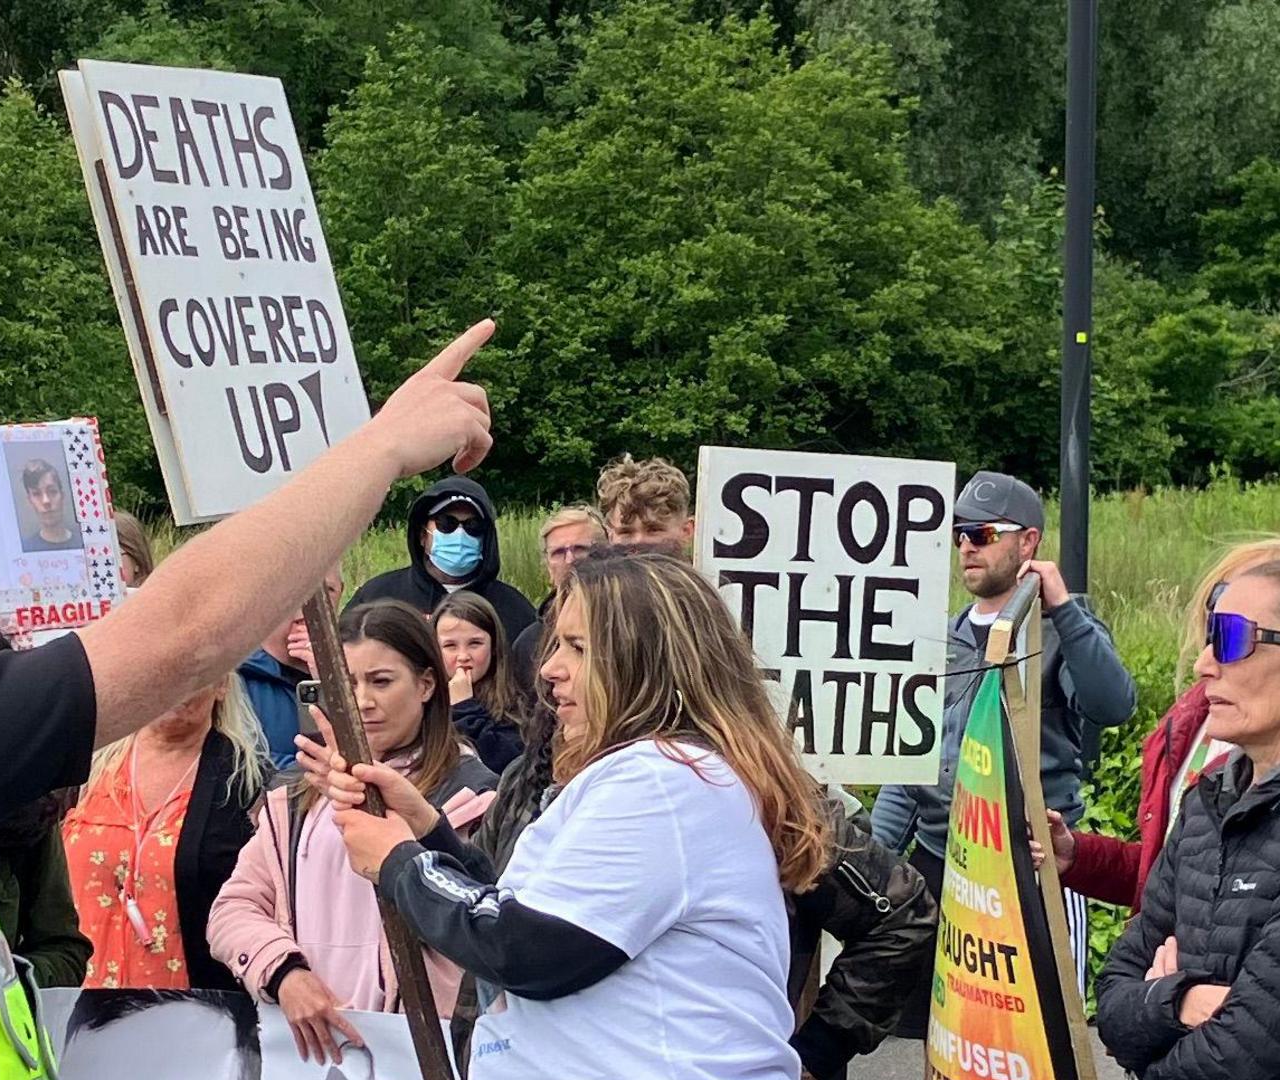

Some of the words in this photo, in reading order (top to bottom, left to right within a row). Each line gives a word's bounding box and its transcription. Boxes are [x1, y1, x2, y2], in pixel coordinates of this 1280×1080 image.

[98, 90, 293, 191] DEATHS
[136, 205, 199, 257] ARE
[212, 206, 317, 263] BEING
[159, 295, 337, 369] COVERED
[713, 473, 946, 568] STOP
[719, 570, 920, 661] THE
[760, 668, 938, 757] ATHS
[947, 972, 1025, 1013] TRAUMATISED
